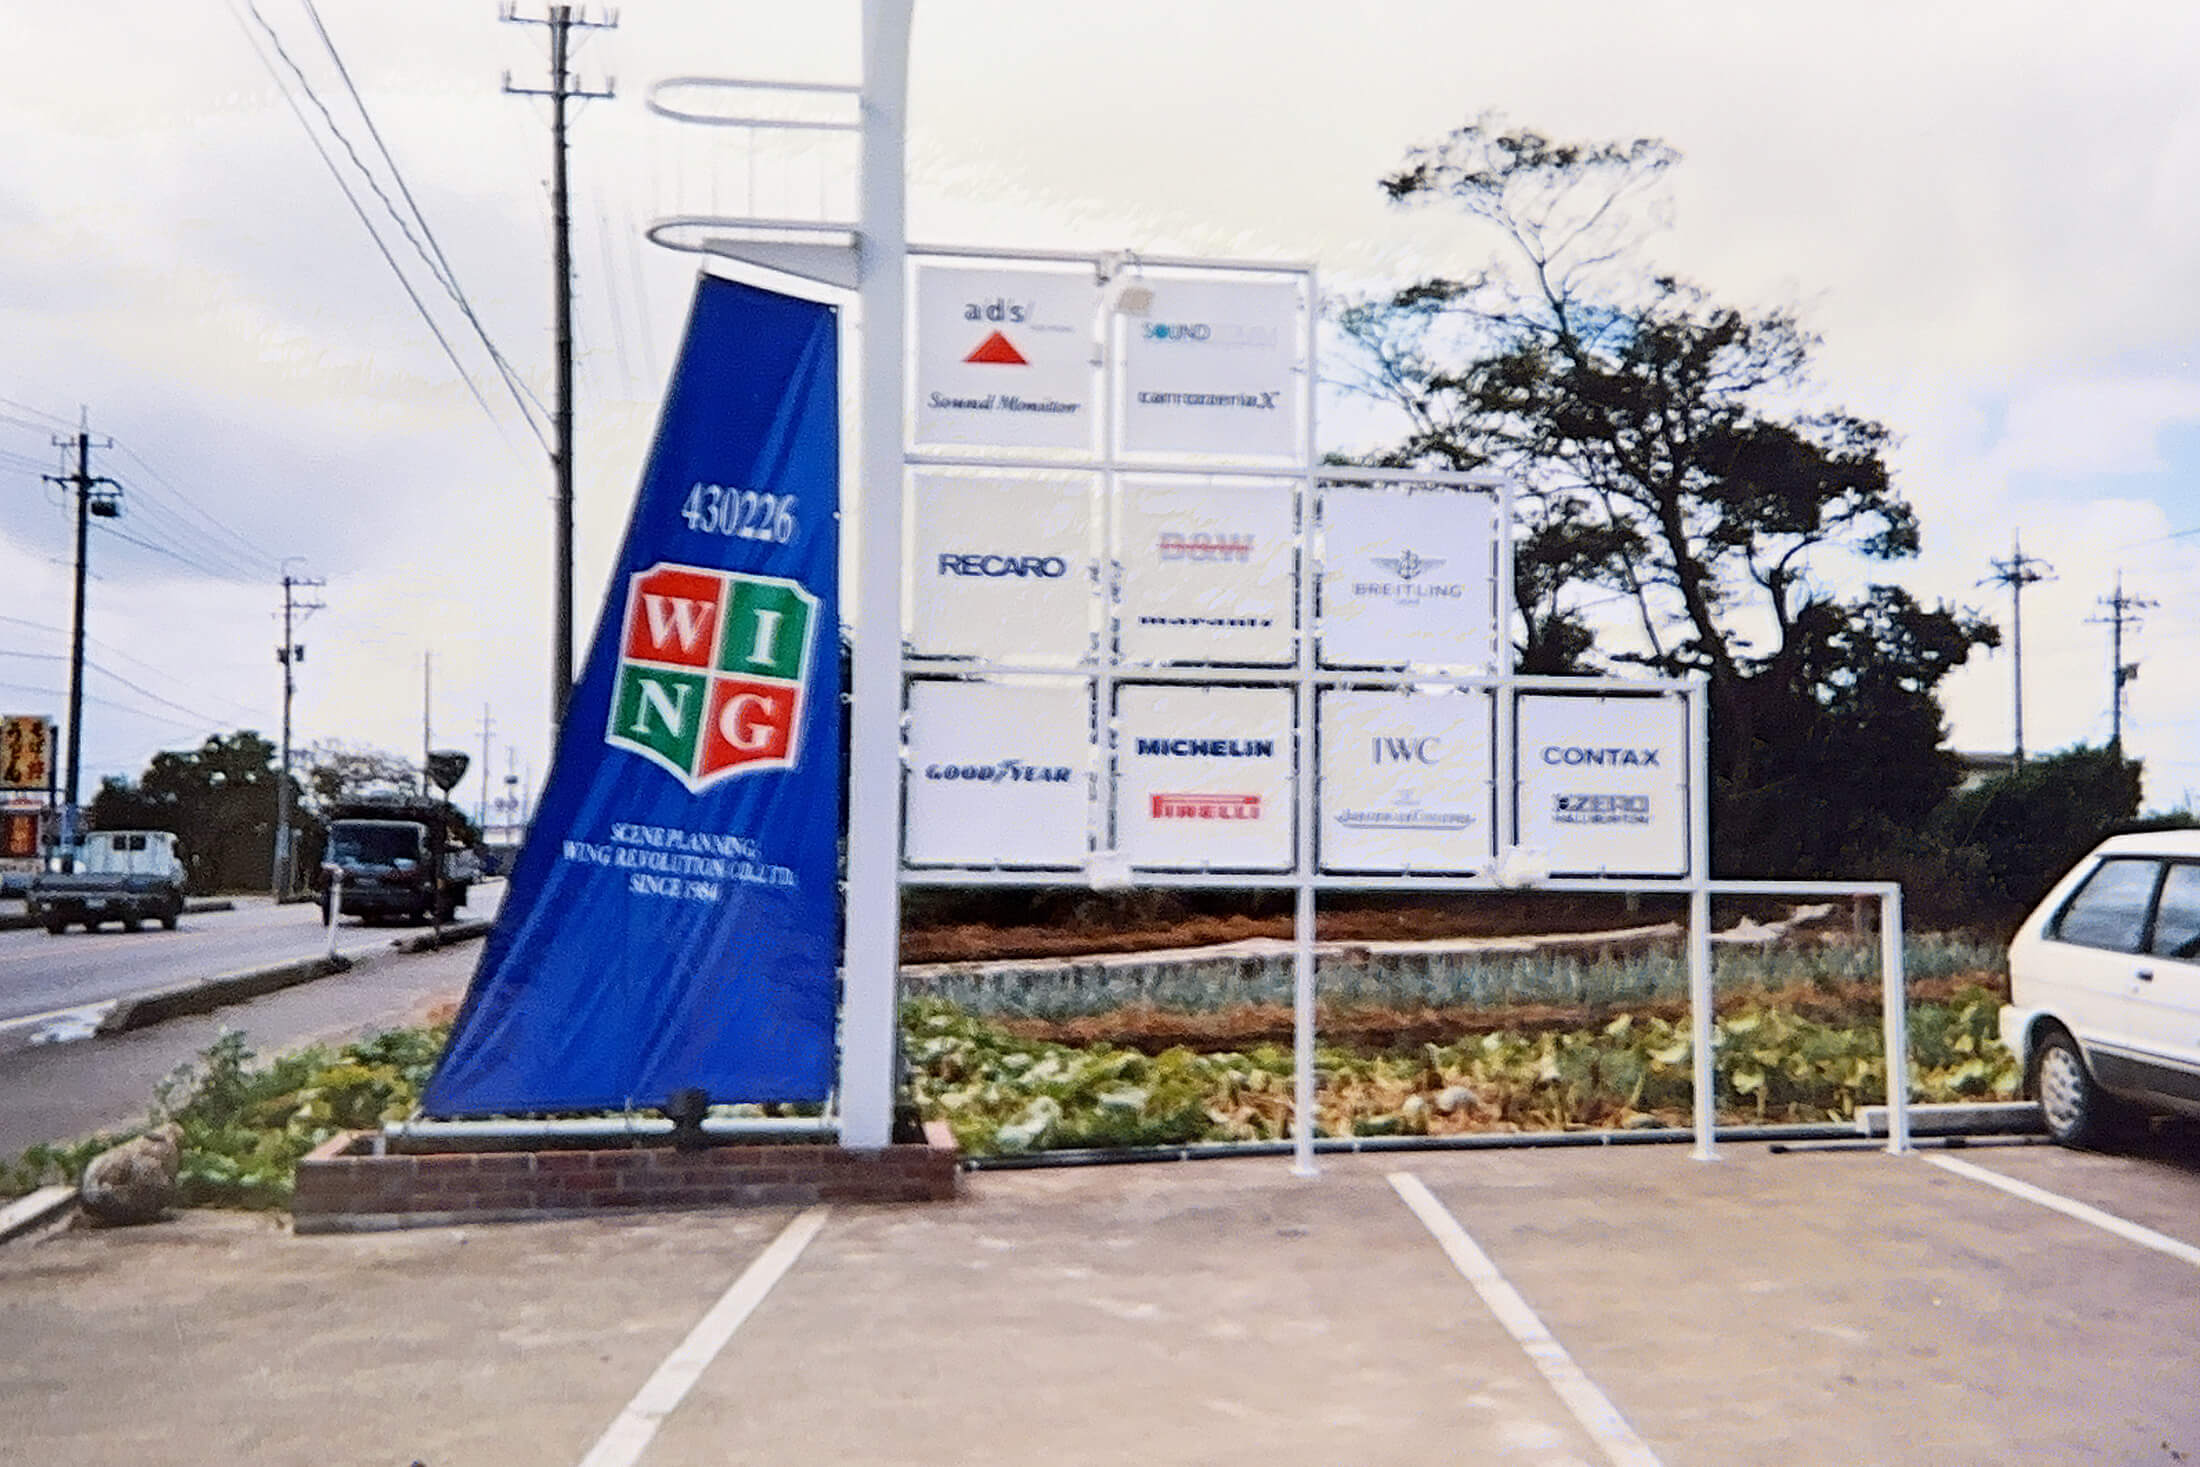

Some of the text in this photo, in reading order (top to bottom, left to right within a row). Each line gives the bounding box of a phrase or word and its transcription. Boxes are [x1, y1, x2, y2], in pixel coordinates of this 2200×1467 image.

[682, 482, 797, 543] 430226
[938, 554, 1067, 578] RECARO
[1354, 583, 1463, 598] BREITLING
[1137, 738, 1274, 757] MICHELIN
[1371, 735, 1441, 765] IWC
[1543, 746, 1660, 766] CONTAX
[1151, 794, 1261, 819] PIRELLI
[563, 840, 612, 865] WING
[614, 847, 725, 878] REVOLUTION
